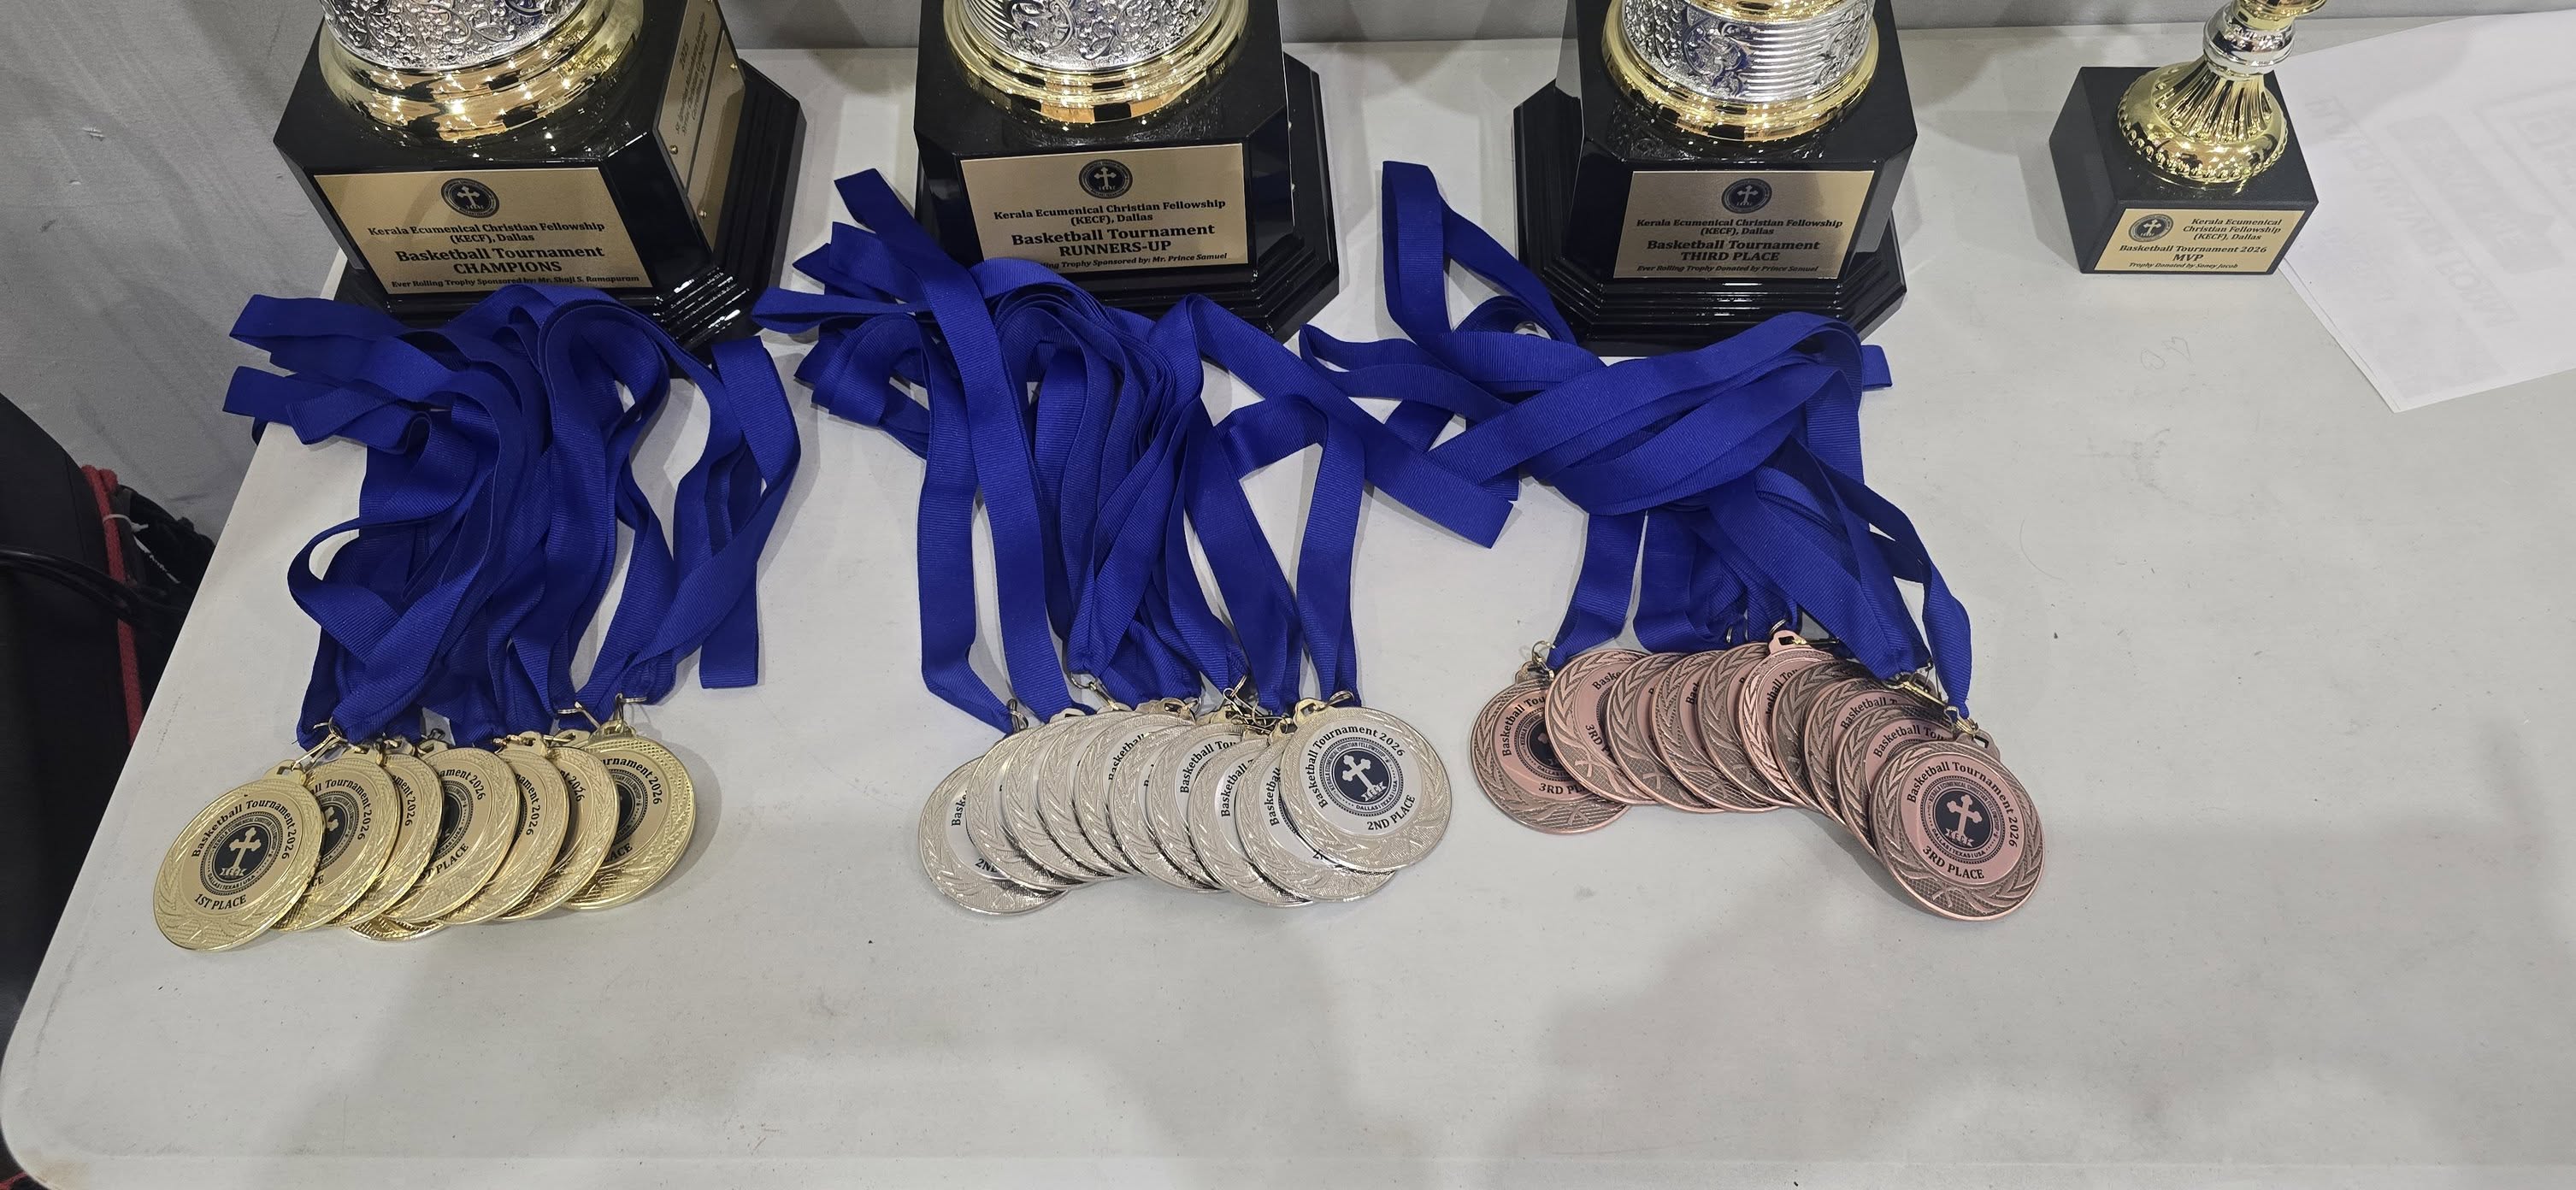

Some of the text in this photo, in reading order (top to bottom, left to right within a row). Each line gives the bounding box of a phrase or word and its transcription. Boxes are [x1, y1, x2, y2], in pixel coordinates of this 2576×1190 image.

[993, 199, 1226, 220] Kerala Ecumenical Christian Fellowship
[1070, 213, 1153, 227] (KECF), Dallas
[368, 221, 605, 236] Kerala Ecumenical Christian Fellowship
[1700, 227, 1739, 236] (KECF),
[1786, 219, 1843, 228] Fellowship
[2229, 226, 2281, 234] Fellowship
[450, 233, 535, 244] (KECF), Dallas
[1011, 224, 1215, 245] Basketball Tournament
[1647, 239, 1820, 250] Basketball Tournament
[395, 246, 605, 262] Basketball Tournament
[1058, 240, 1171, 256] RUNNERS-UP
[1681, 251, 1781, 261] THIRD PLACE
[453, 261, 563, 274] CHAMPIONS
[1062, 259, 1091, 268] Trophy
[1093, 257, 1136, 267] Sponsored
[477, 277, 522, 286] Sponsored
[586, 275, 640, 284] Ramapuram
[1840, 697, 1887, 729] Basketball
[1500, 704, 1525, 757] Basketball
[1585, 724, 1603, 745] 3RD
[1873, 724, 1921, 758] Basketball
[1180, 744, 1215, 793] Basketball
[1306, 726, 1406, 809] Basketball Tournament 2026
[469, 775, 486, 800] 2026
[568, 775, 587, 803] 2026
[649, 776, 663, 804] 2026
[1221, 763, 1247, 817] Basketball
[1539, 783, 1564, 794] 3RD
[325, 779, 372, 810] Tournament
[357, 810, 372, 840] 2026
[404, 796, 416, 827] 2026
[1366, 794, 1416, 830] 2ND PLACE
[1907, 761, 2019, 848] Basketball Tournament 2026
[192, 804, 243, 857] Basketball
[245, 799, 296, 830] Tournament
[281, 829, 297, 860] 2026
[526, 804, 540, 836] 2026
[436, 843, 469, 875] PLACE
[1923, 845, 1984, 880] 3RD PLACE
[194, 893, 247, 910] 1ST PLACE
